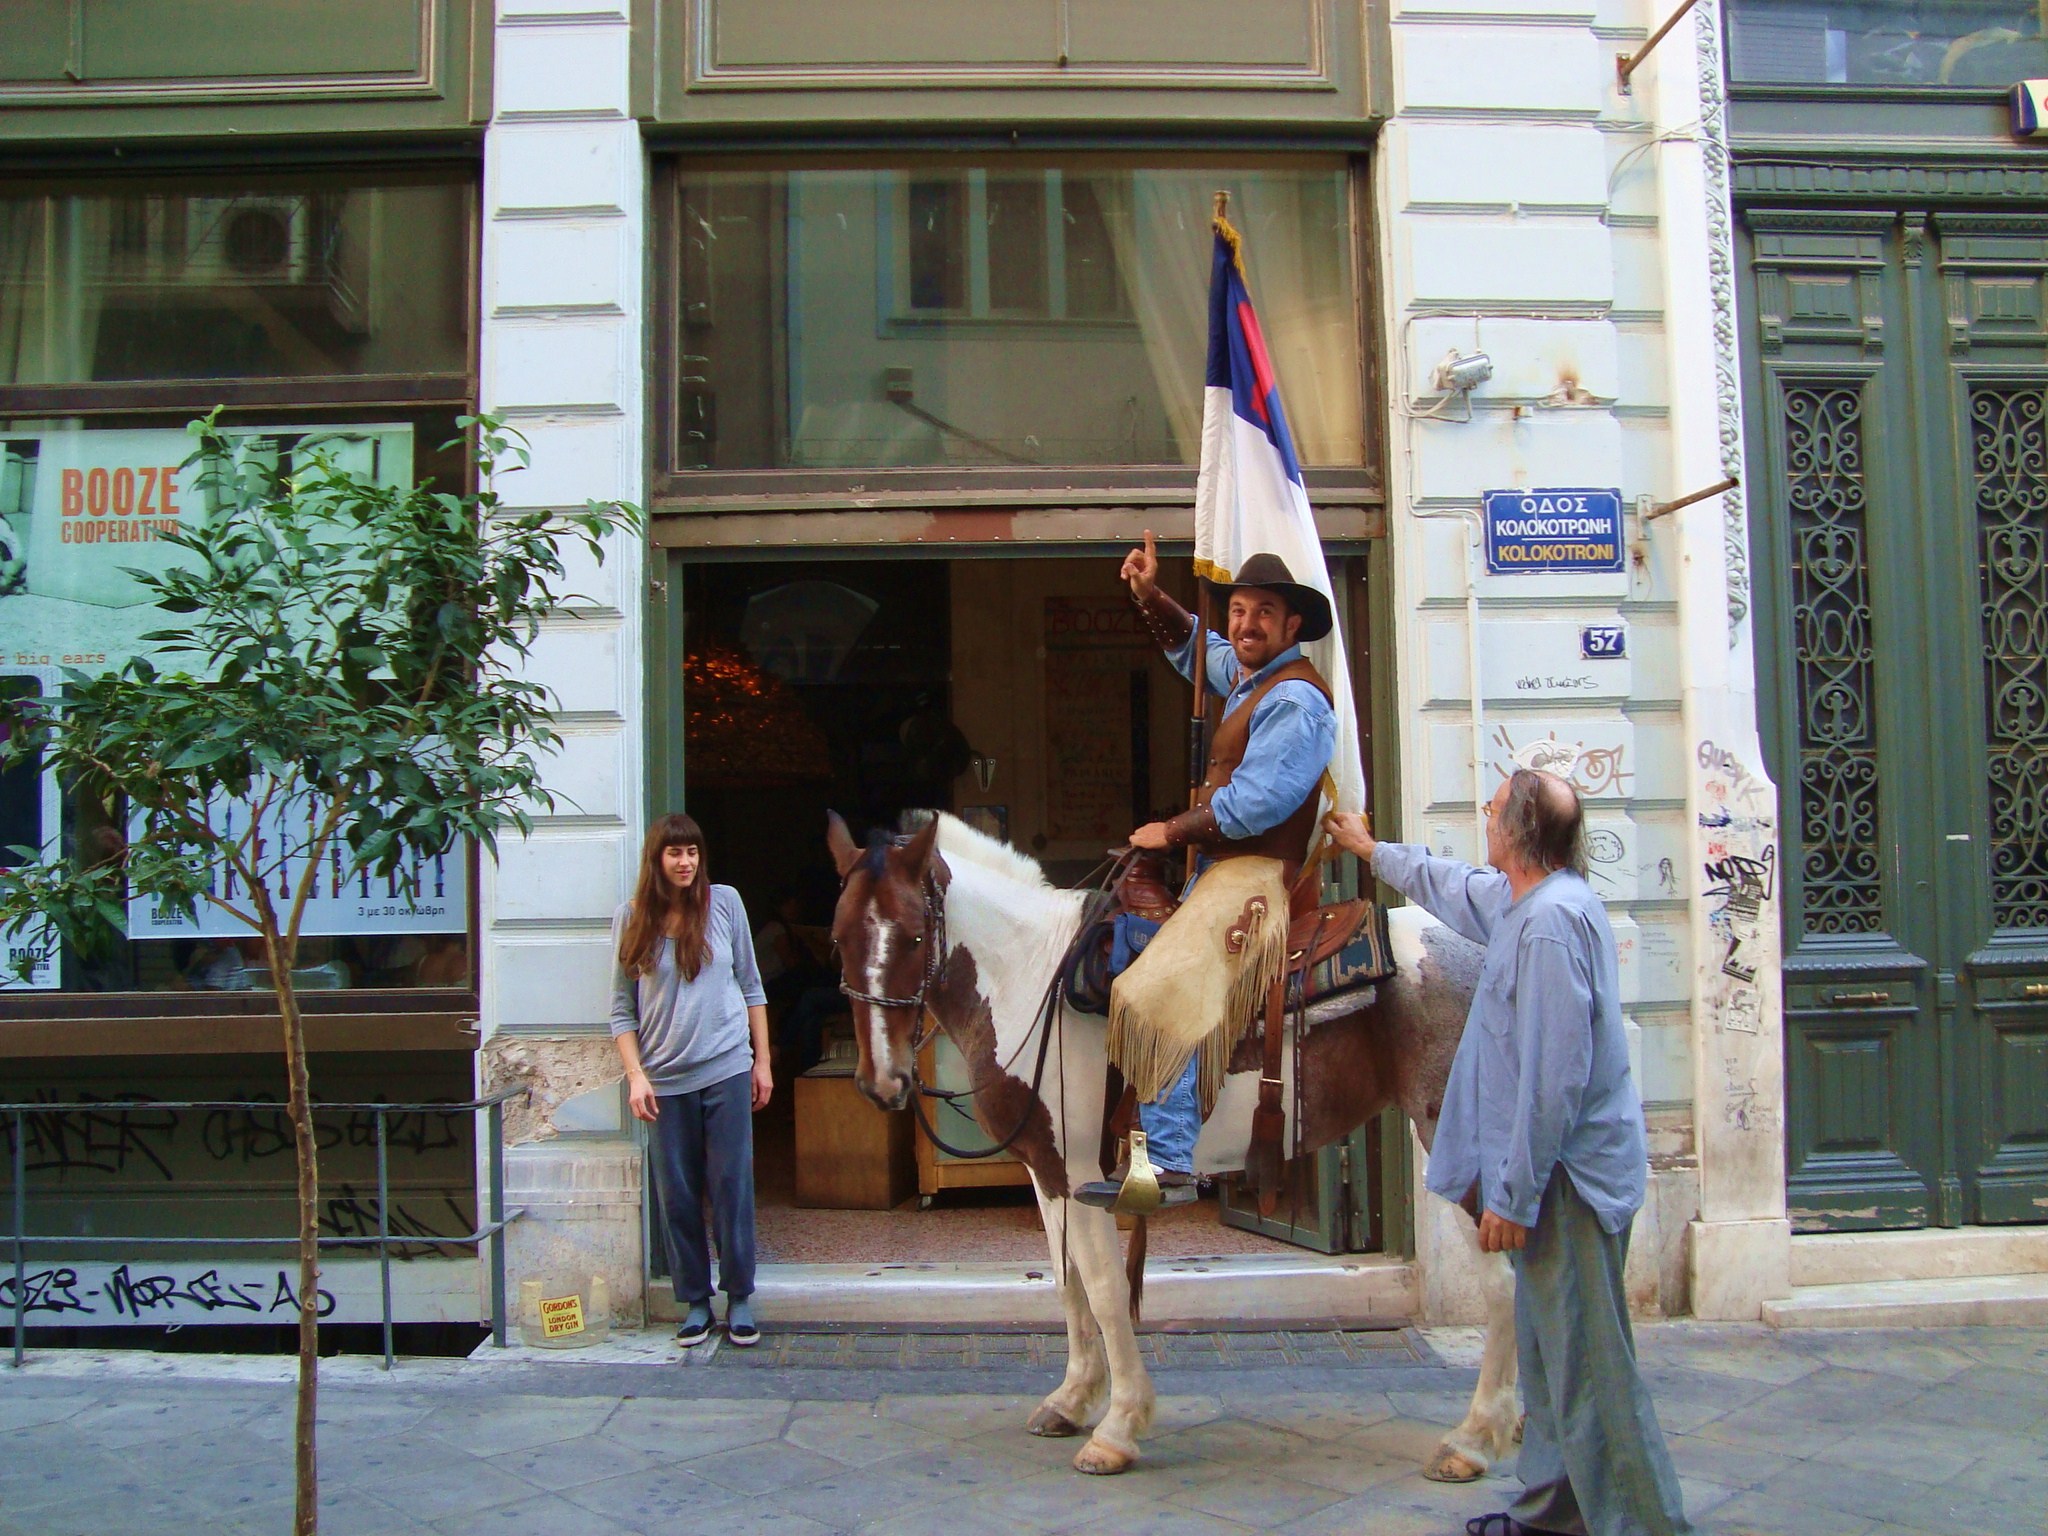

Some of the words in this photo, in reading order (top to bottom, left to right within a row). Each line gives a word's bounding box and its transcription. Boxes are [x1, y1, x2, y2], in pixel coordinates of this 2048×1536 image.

[62, 467, 180, 516] BOOZE
[1521, 497, 1588, 513] ΟΔΟΣ
[1496, 518, 1612, 536] ΚΟΛΟΚΟΤΡΩΝΗ
[1498, 543, 1614, 561] KOLOKOTRONI
[1589, 629, 1617, 651] 57
[62, 653, 106, 664] ears
[151, 908, 183, 919] BZE
[358, 906, 364, 916] 3
[367, 908, 380, 918] με
[383, 906, 396, 916] 30
[398, 905, 445, 917] οκώβρη
[548, 1313, 576, 1324] LONDON
[549, 1325, 563, 1333] DRY
[565, 1321, 579, 1330] GIN
